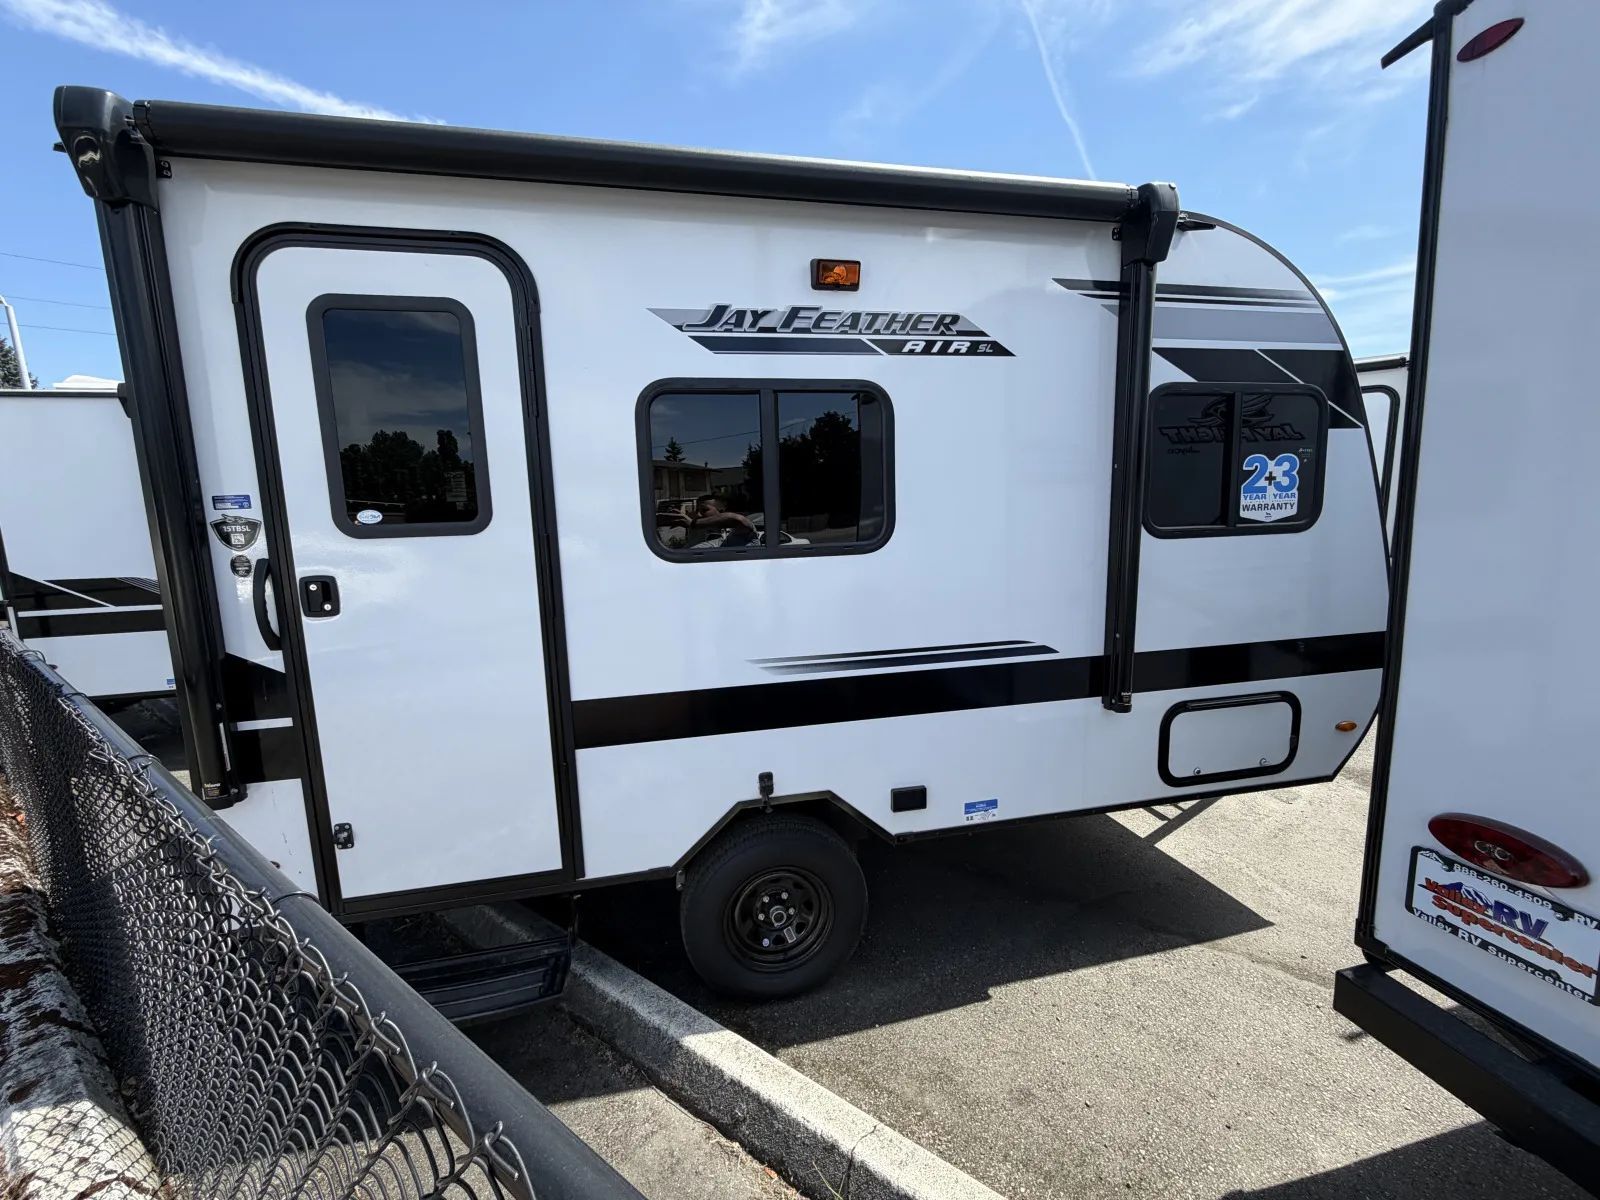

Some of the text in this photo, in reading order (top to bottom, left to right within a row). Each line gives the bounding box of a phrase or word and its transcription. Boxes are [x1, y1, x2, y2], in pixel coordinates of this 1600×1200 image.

[682, 303, 962, 335] JAY FEATHER
[901, 340, 994, 355] AIR SL
[1242, 493, 1267, 501] YEAR
[1272, 492, 1297, 500] YEAR
[1242, 502, 1296, 512] WARRANTY
[222, 525, 251, 533] 15TBSL
[1453, 863, 1600, 929] 888-260-4509 RV
[1492, 899, 1549, 939] RV
[1431, 894, 1597, 979] Supercenter
[1413, 907, 1593, 1002] Valley RV Supercenter
